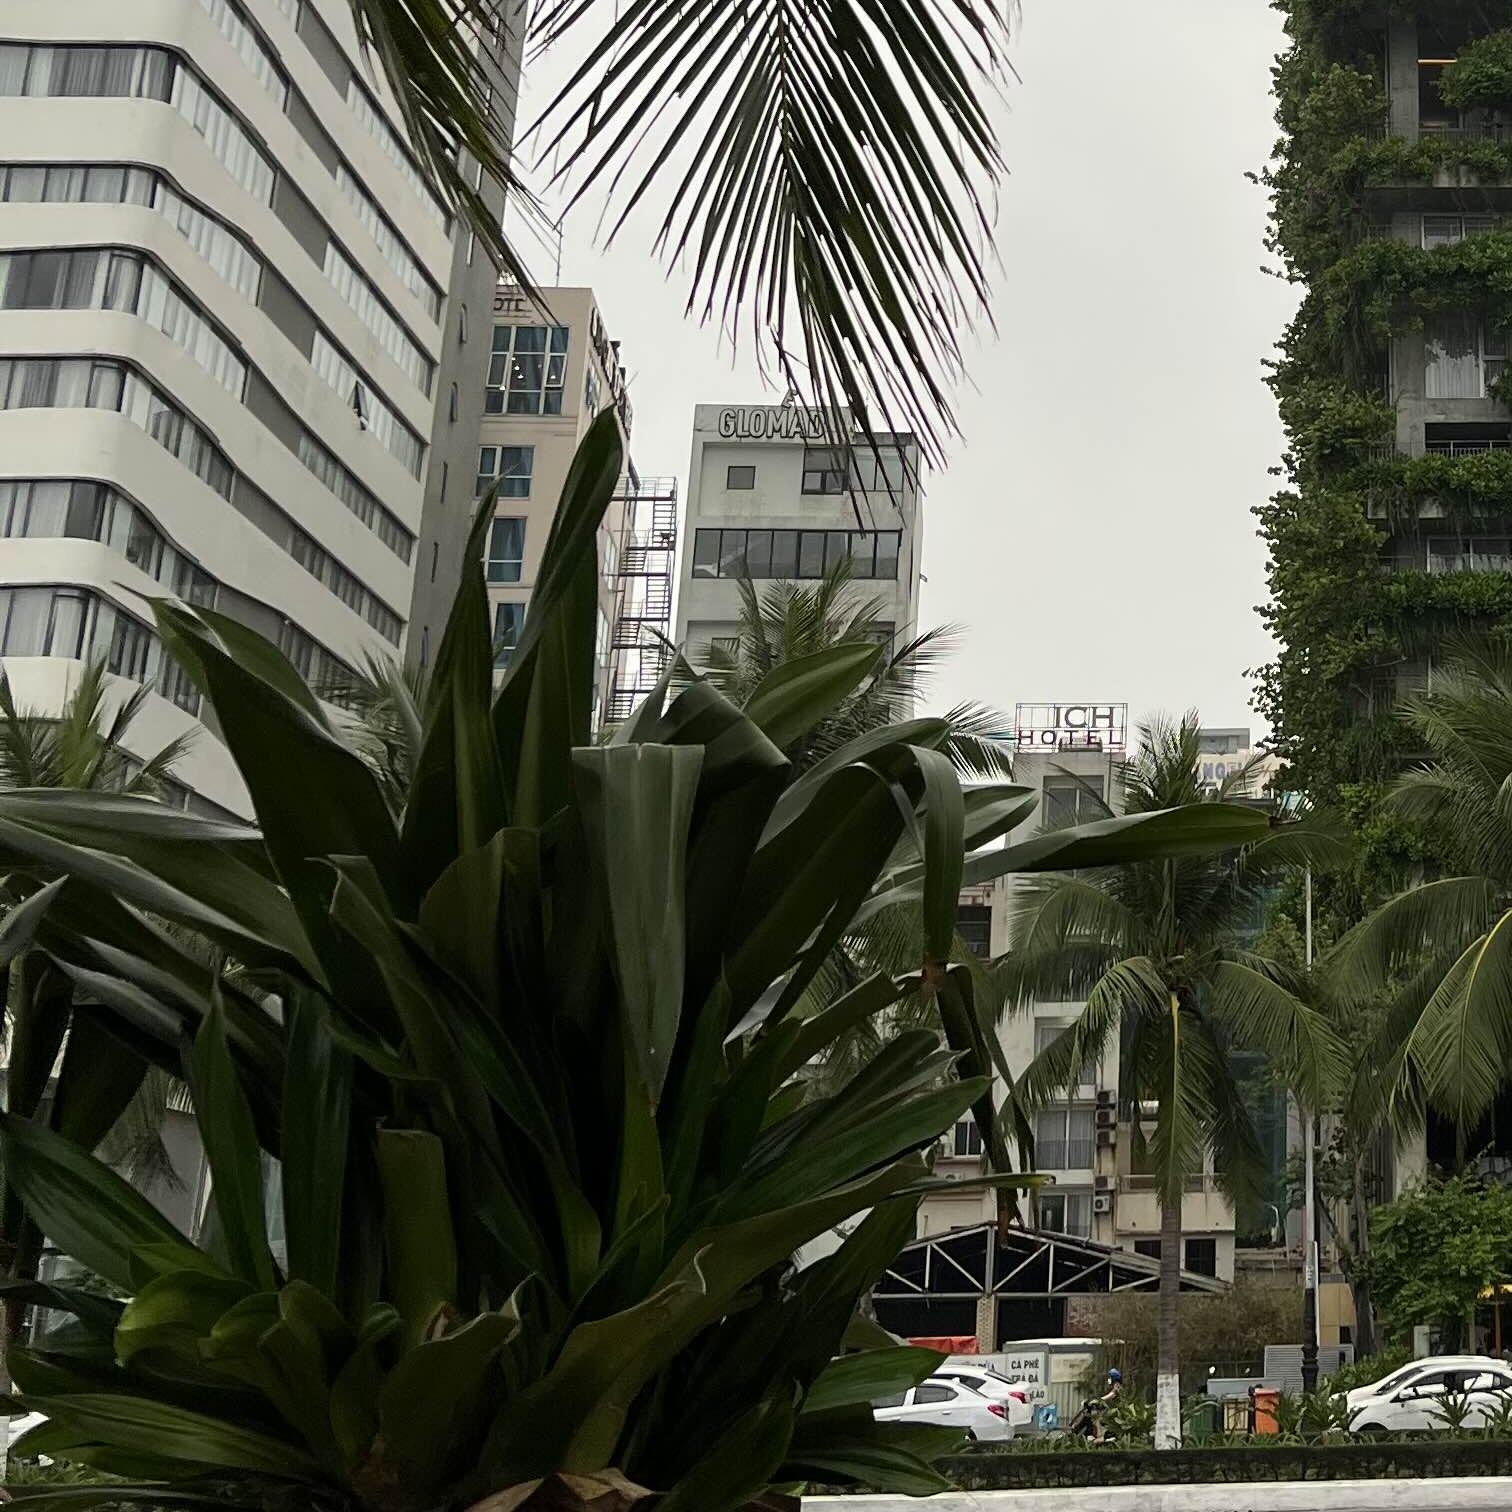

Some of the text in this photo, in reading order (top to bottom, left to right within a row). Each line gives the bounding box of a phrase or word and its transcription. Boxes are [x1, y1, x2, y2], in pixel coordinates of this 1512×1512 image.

[719, 408, 824, 439] GLOMAD
[1055, 706, 1114, 729] ICH
[1018, 729, 1123, 745] HOTEL
